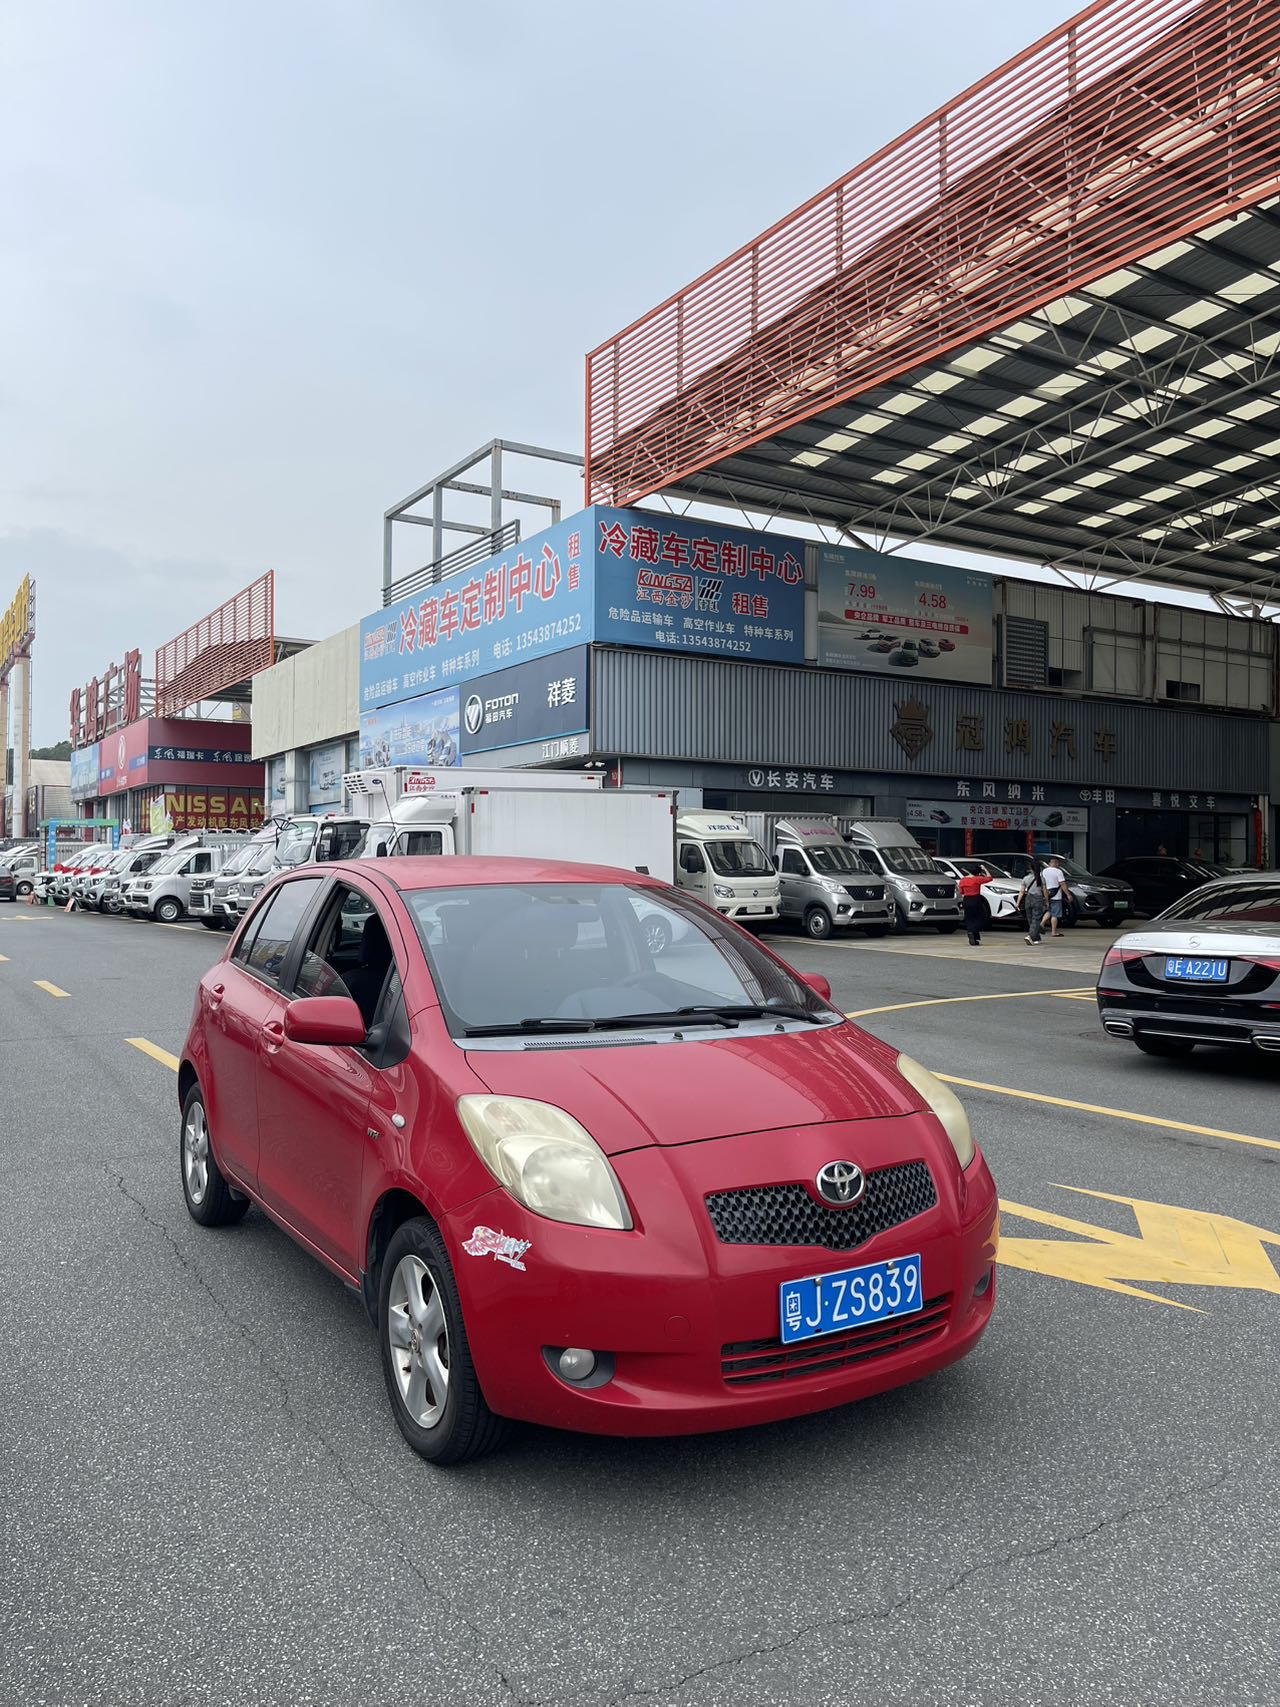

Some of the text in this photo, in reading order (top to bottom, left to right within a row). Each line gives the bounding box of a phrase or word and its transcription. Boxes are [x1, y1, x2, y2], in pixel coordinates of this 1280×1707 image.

[568, 531, 581, 592] 租售
[598, 520, 804, 586] 冷藏车定制中心
[638, 569, 694, 592] KINGSA
[848, 583, 876, 600] 7.99
[399, 542, 562, 656] 冷藏车定制中心
[637, 587, 694, 609] 江西金沙
[732, 592, 769, 618] 租售
[919, 593, 947, 609] 4.58
[608, 606, 794, 642] 危险品运输车 高空作业车 特种车系列
[441, 649, 480, 676] 特种车系列
[485, 692, 520, 711] FOTON
[547, 677, 577, 708] 祥菱
[956, 713, 1119, 762] 冠鸿汽车
[767, 770, 834, 791] 长安汽车
[957, 780, 1045, 801] 东风纳米
[1092, 789, 1115, 804] 丰田
[1152, 792, 1216, 809] 喜悦交车
